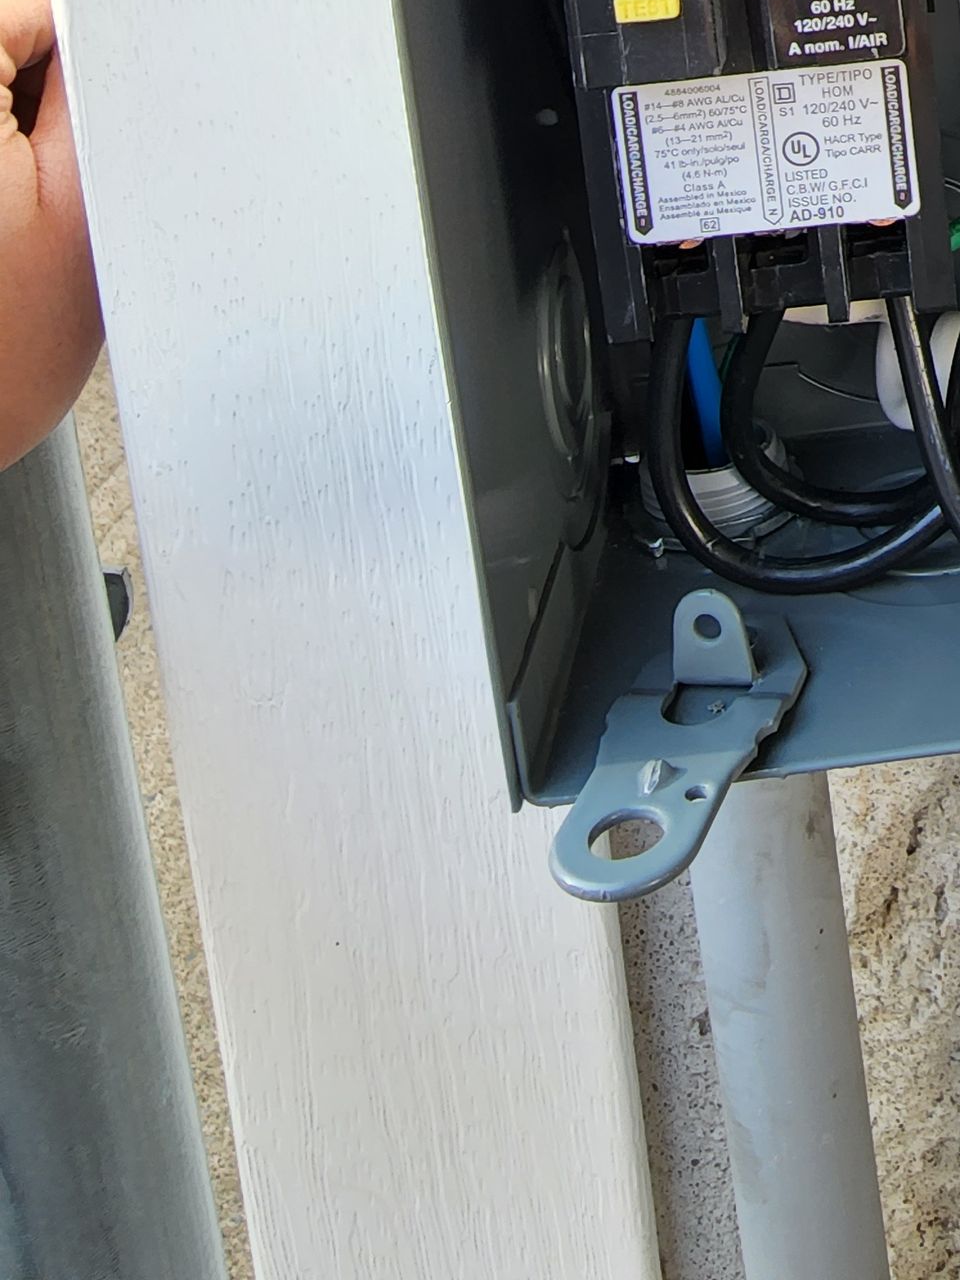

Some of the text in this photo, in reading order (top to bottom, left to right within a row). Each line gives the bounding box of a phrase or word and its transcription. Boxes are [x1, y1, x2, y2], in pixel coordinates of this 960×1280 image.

[810, 0, 831, 15] 60
[793, 14, 855, 34] 120/240
[788, 32, 888, 57] A nom. I/AIR
[798, 68, 873, 87] TYPE/TIPO
[821, 84, 854, 100] HOM
[686, 96, 713, 108] AWG
[802, 99, 856, 116] 120/240
[779, 107, 795, 118] S1
[688, 120, 714, 132] AWG
[821, 114, 863, 128] 60 Hz
[884, 66, 907, 192] LOAD/CARGA/CHARGE
[823, 131, 883, 146] HACR Type
[753, 80, 779, 217] LOAD/CARGA/CHARGE N
[824, 144, 882, 160] Tipo CARR
[664, 160, 676, 170] 41
[784, 168, 829, 183] LISTED
[683, 180, 727, 193] Class A
[657, 188, 748, 205] Assembled in Mexico
[788, 191, 857, 209] ISSUE NO.
[659, 199, 724, 213] Ensamblado en
[790, 205, 845, 223] AD-910
[703, 219, 718, 230] 62
